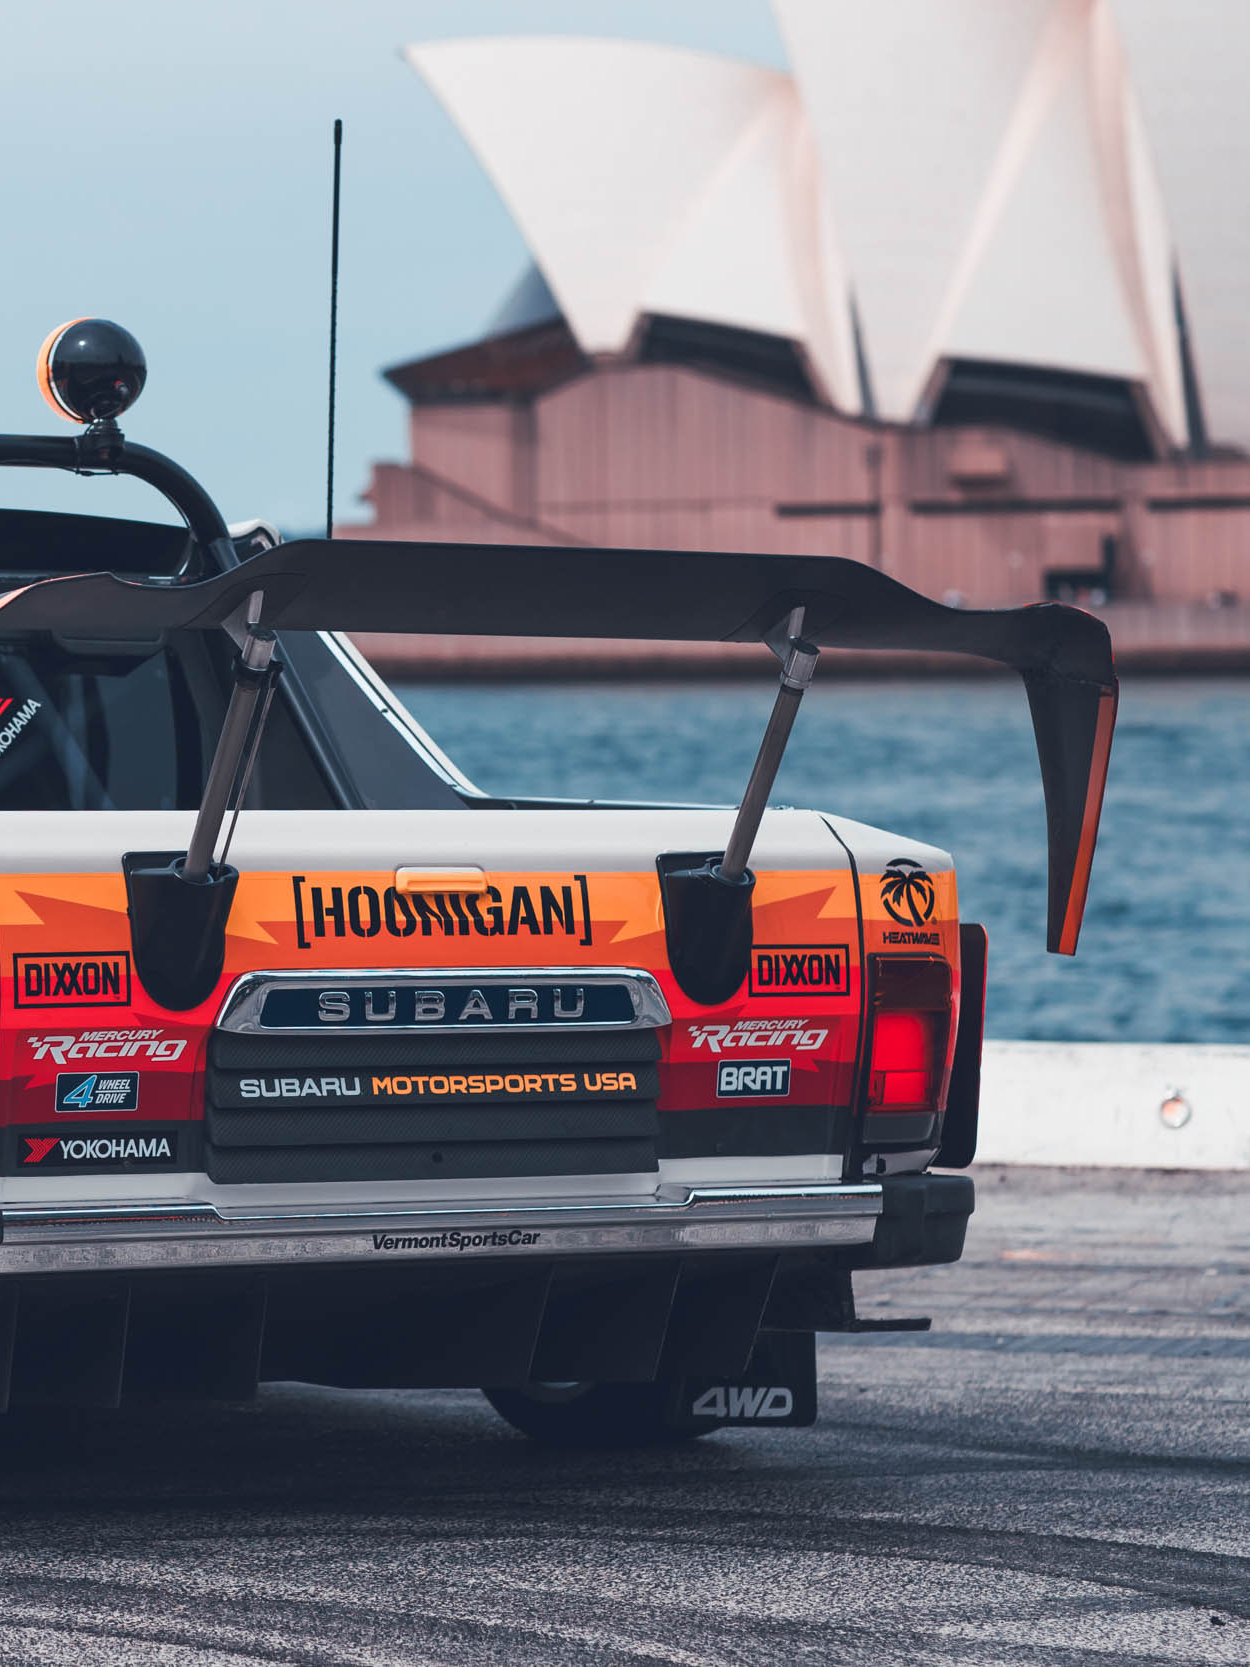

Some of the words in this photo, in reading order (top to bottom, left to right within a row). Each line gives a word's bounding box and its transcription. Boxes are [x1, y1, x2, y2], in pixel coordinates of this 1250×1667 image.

[882, 931, 940, 945] HEATWAVE
[24, 961, 120, 997] DIXXON
[757, 954, 841, 987] DIXXON
[317, 988, 585, 1022] SUBARU
[78, 1029, 164, 1042] MERCURY
[734, 1019, 809, 1031] MERCURY
[27, 1036, 187, 1065] Racing
[688, 1025, 828, 1053] Racing
[62, 1074, 98, 1108] 4
[97, 1079, 131, 1090] WHEEL
[239, 1077, 362, 1098] SUBARU
[371, 1073, 577, 1096] MOTORSPORTS
[583, 1072, 638, 1092] USA
[720, 1066, 788, 1091] BRAT
[95, 1093, 126, 1105] DRIVE
[60, 1138, 171, 1160] YOKOHAMA
[693, 1387, 793, 1418] 4WD
